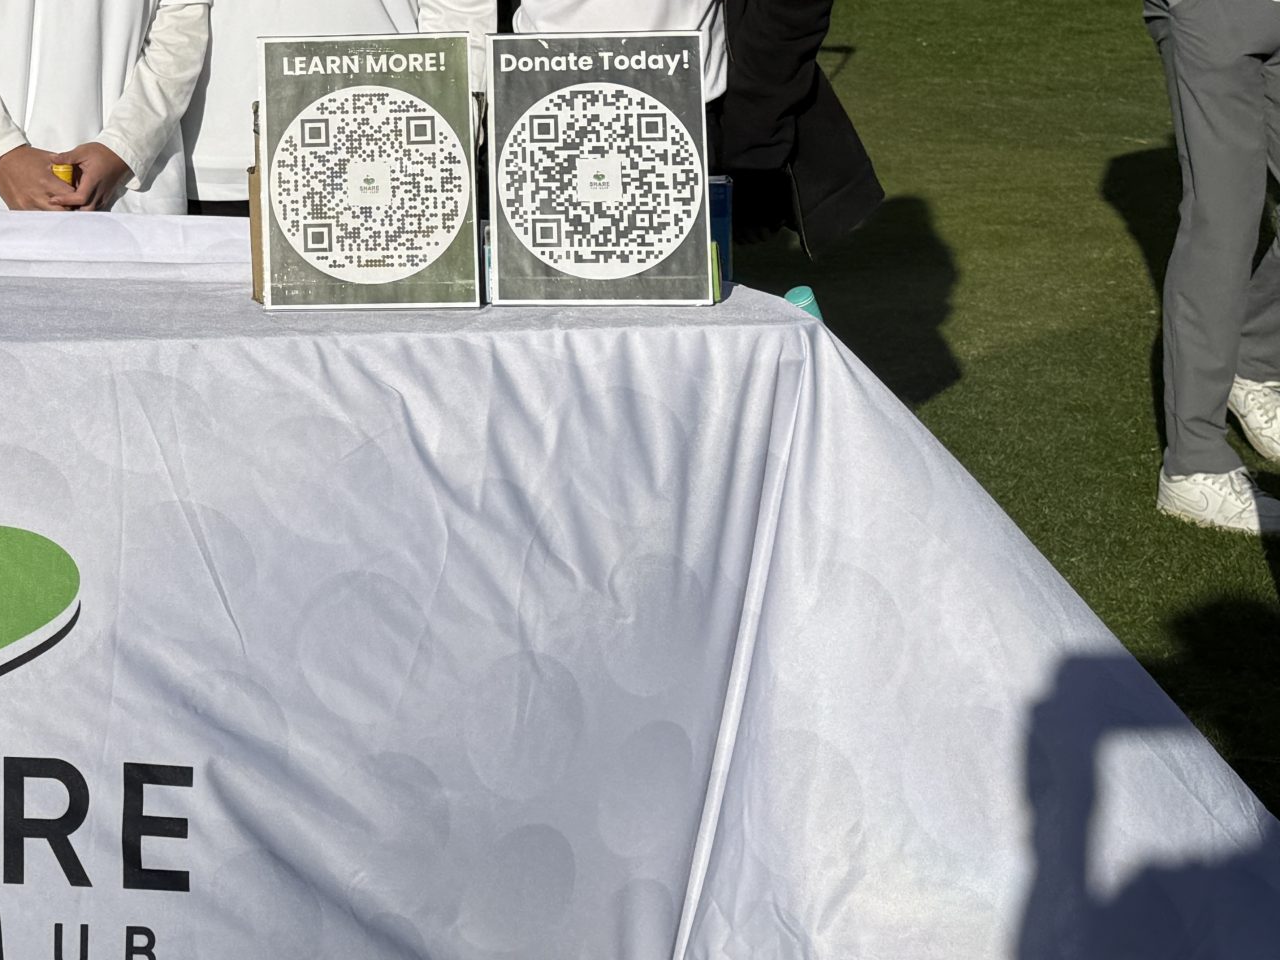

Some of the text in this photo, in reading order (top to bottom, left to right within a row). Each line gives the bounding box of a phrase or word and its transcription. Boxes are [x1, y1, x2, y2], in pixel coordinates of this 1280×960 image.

[282, 52, 447, 76] LEARN MORE!
[500, 49, 690, 76] Donate Today!
